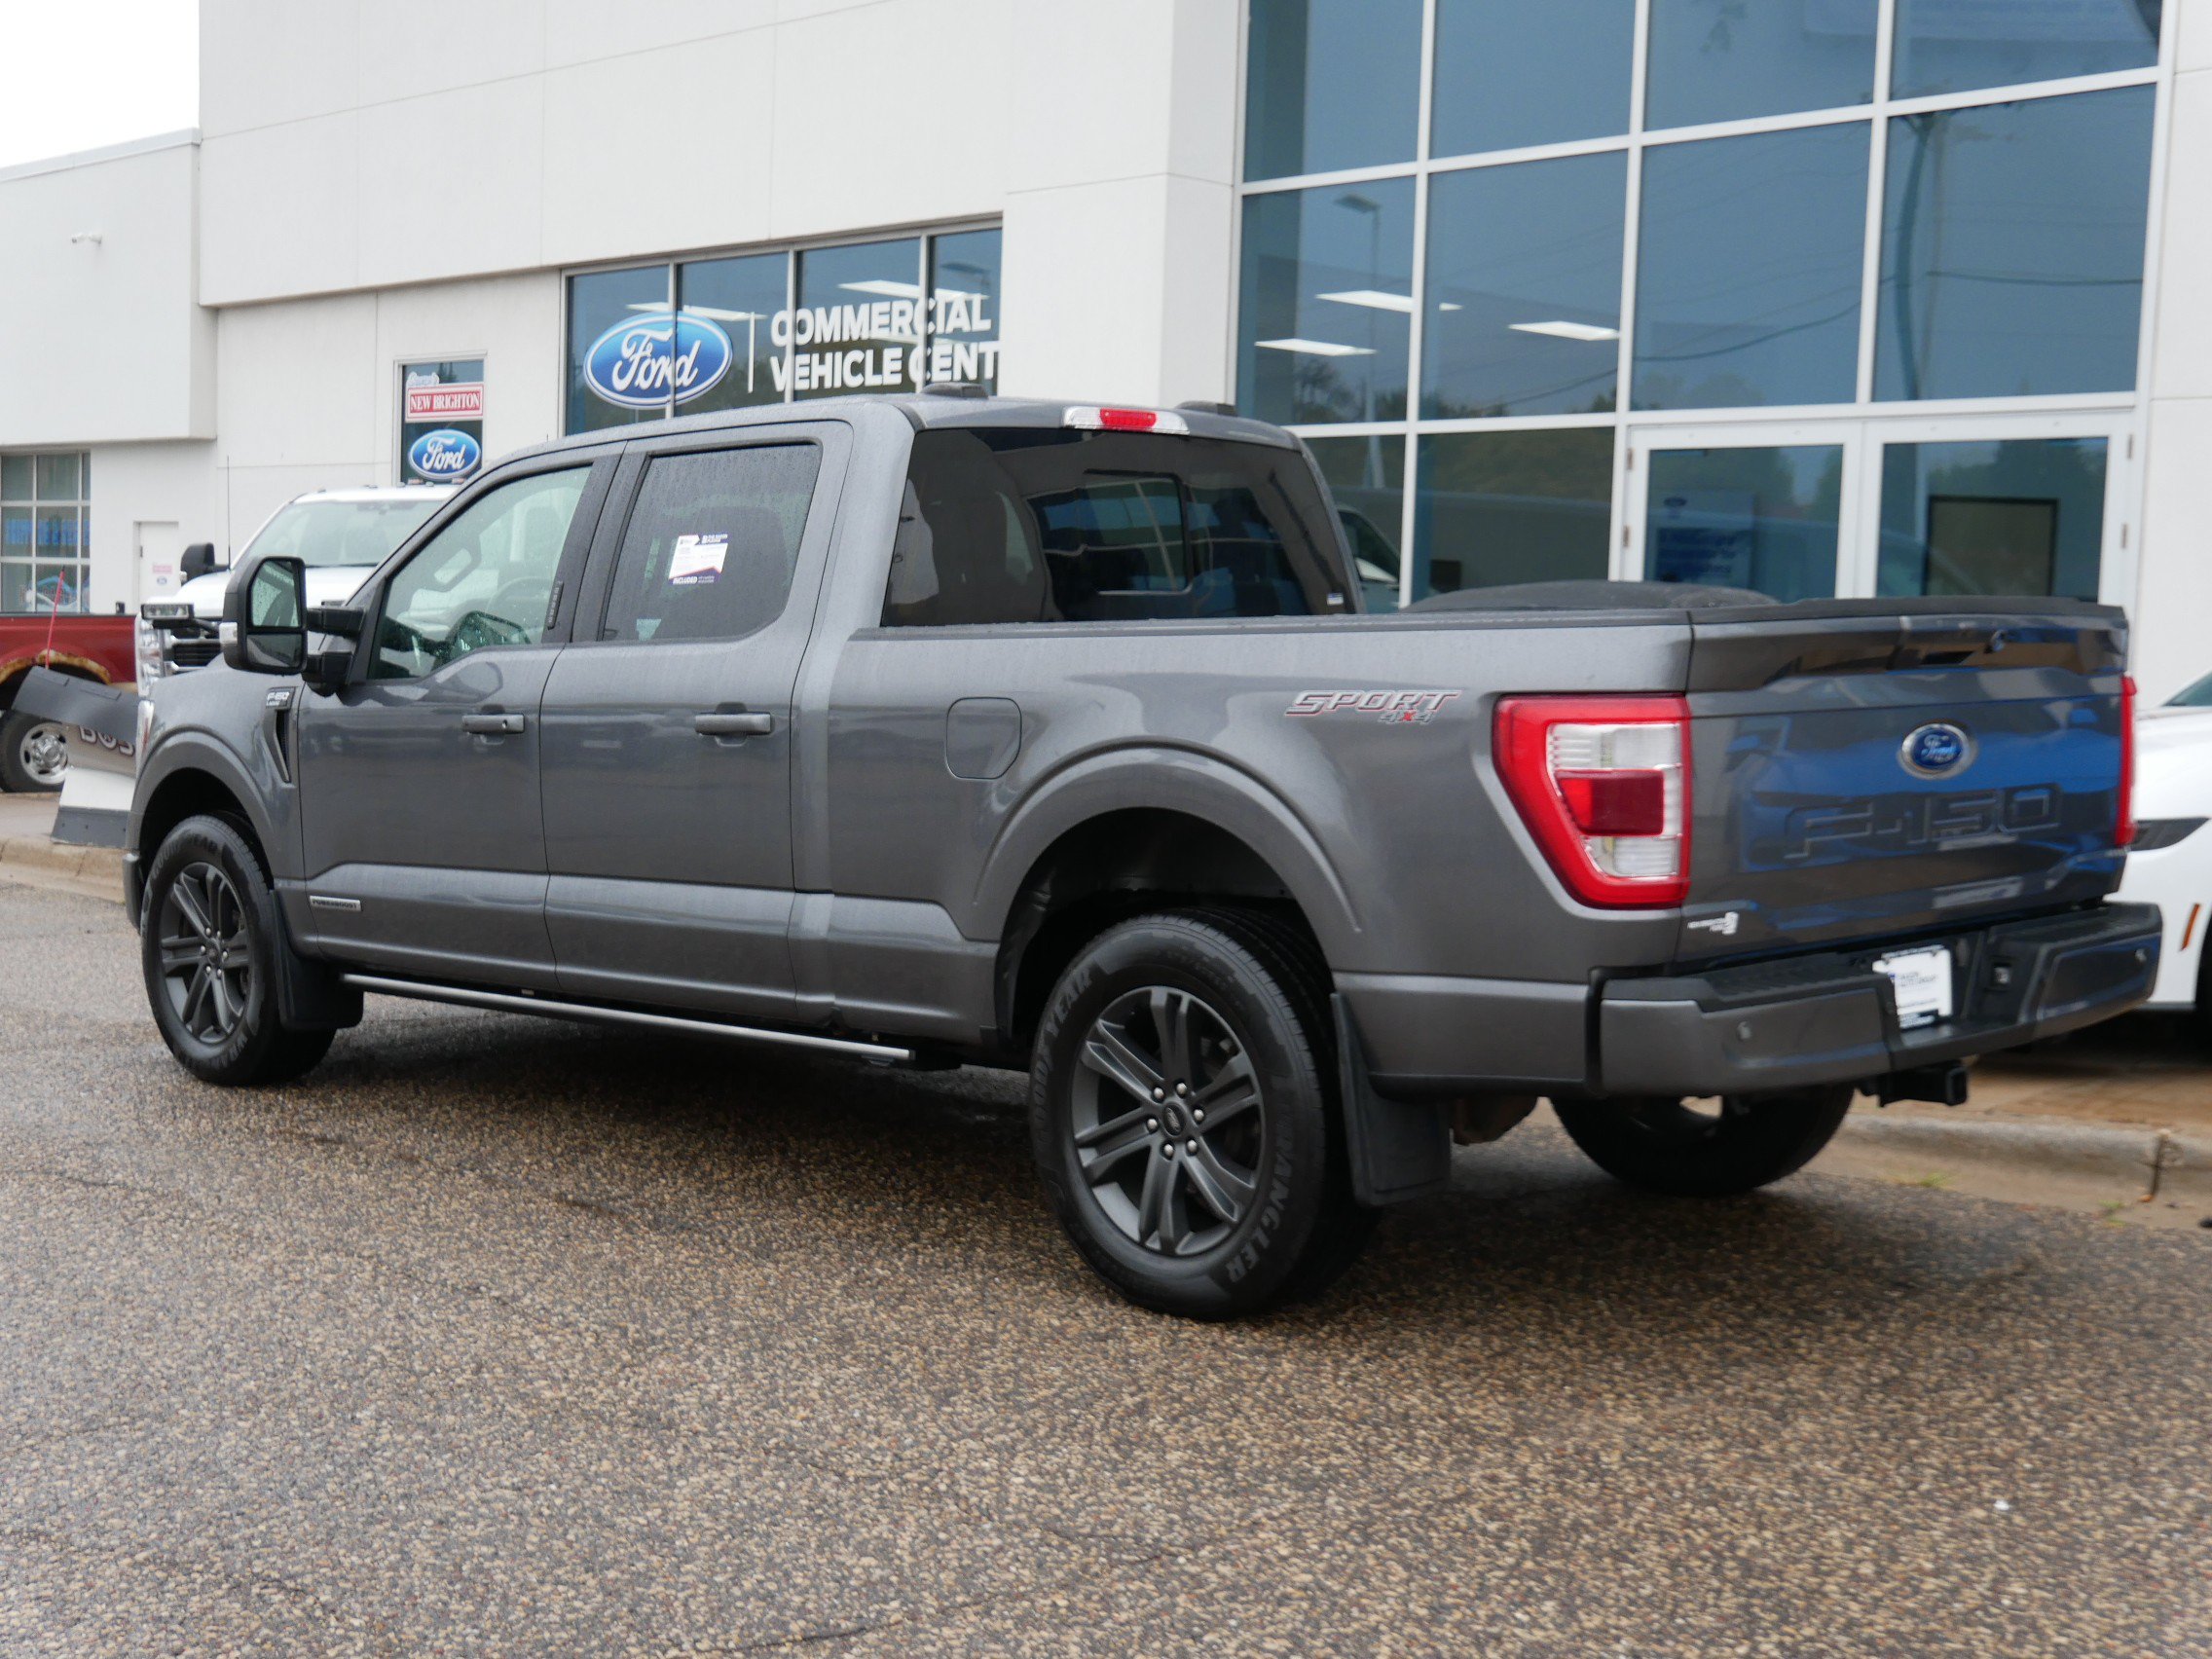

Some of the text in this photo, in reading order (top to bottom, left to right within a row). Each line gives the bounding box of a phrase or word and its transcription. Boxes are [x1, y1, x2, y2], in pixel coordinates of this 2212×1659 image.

[770, 293, 992, 348] COMMERCIAL
[611, 327, 702, 392] Ford
[770, 347, 903, 392] VEHICLE
[410, 391, 480, 412] NEW BRIGHTON
[422, 435, 467, 470] Ford
[1284, 689, 1462, 717] SPORT
[1783, 783, 2063, 859] F-150
